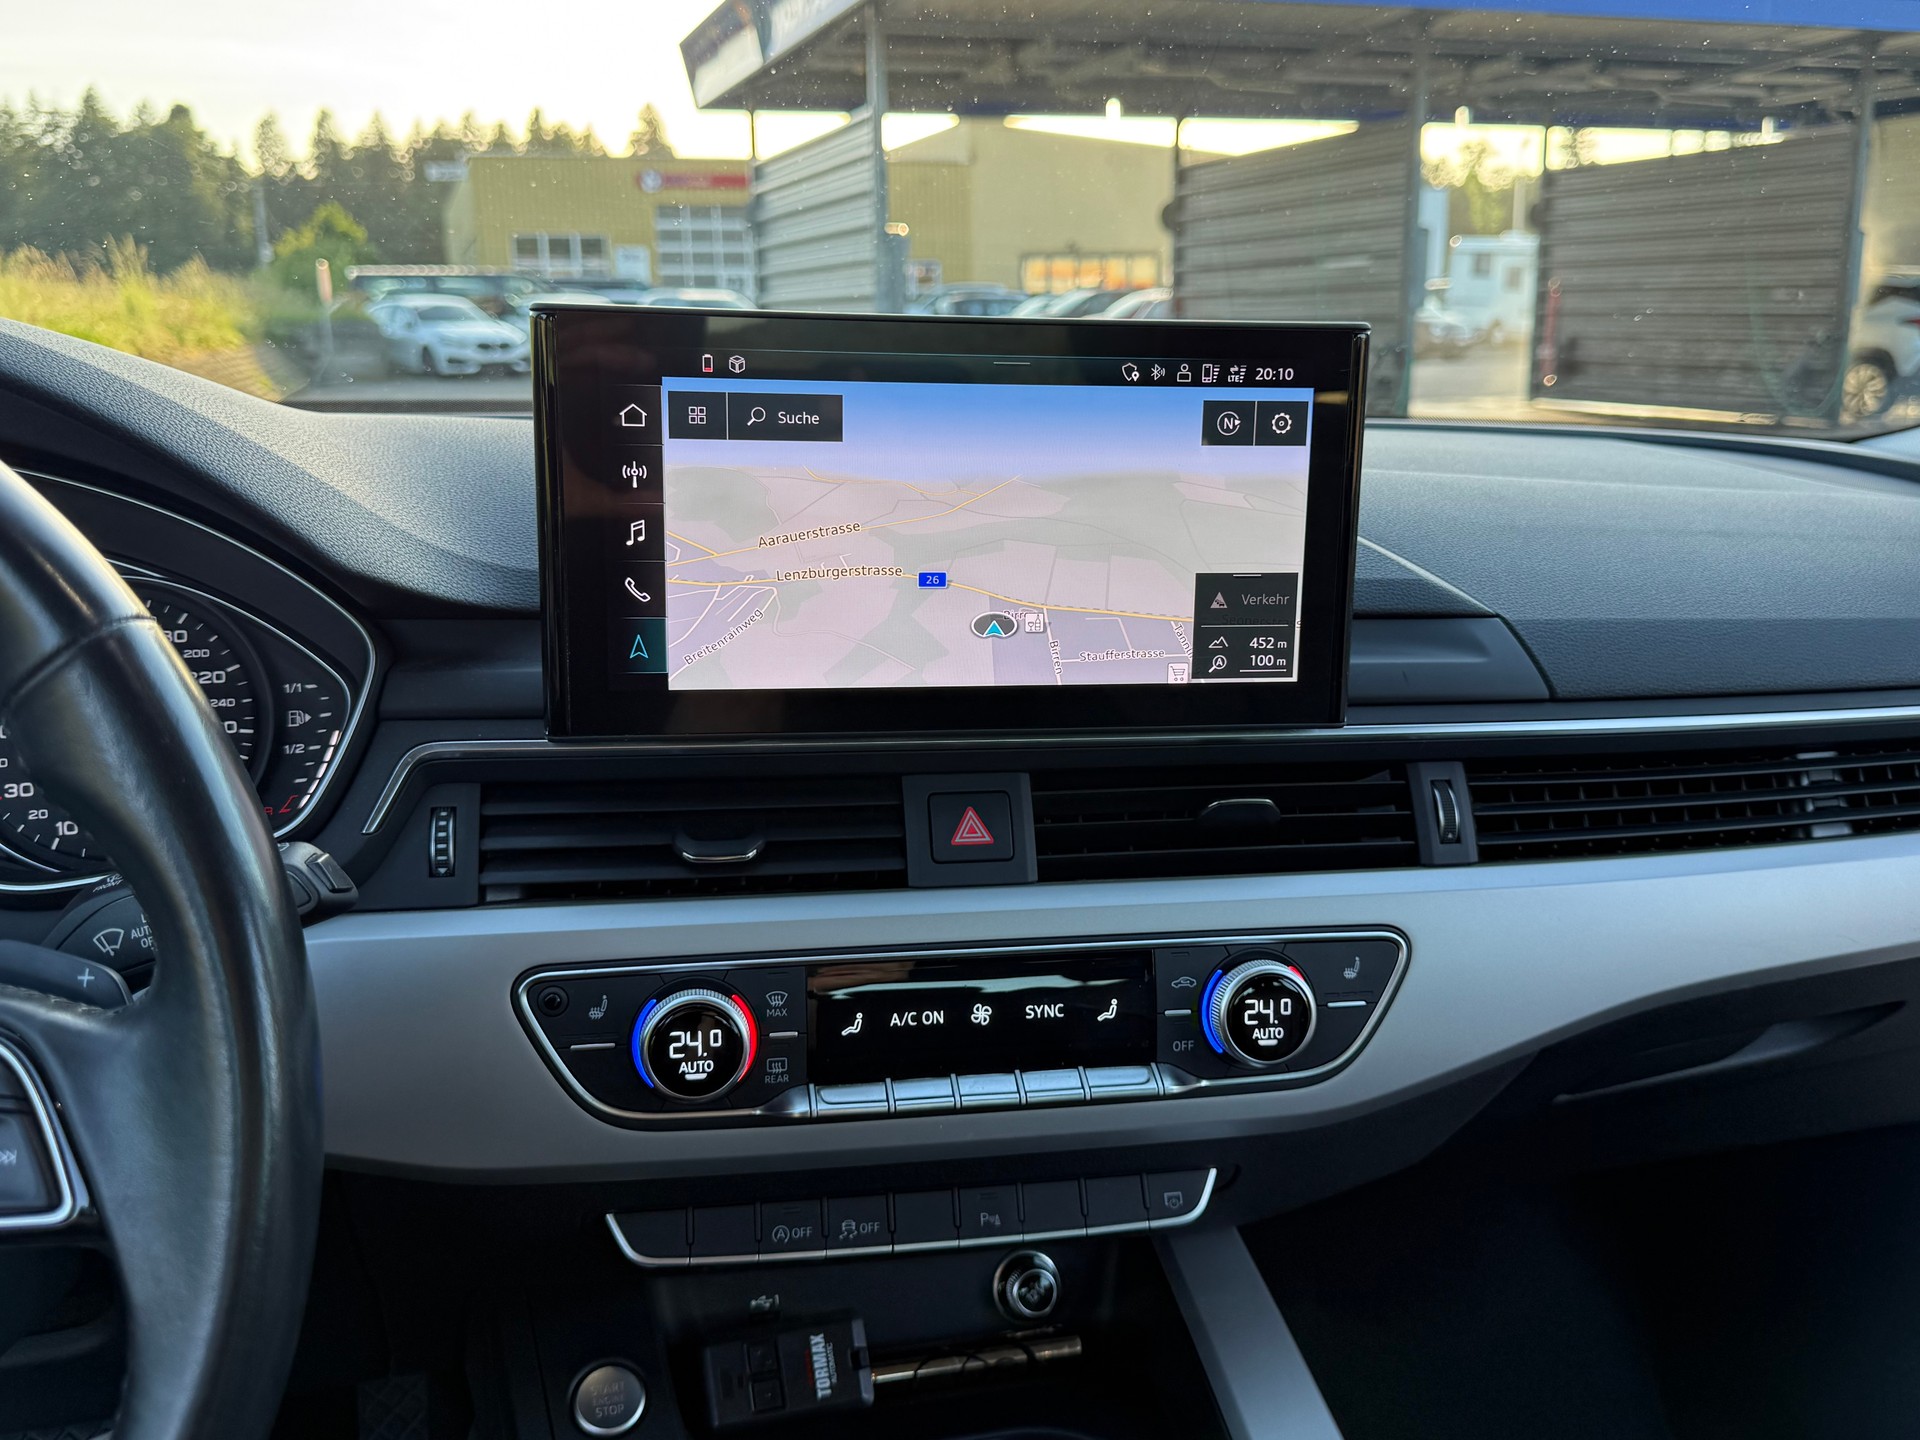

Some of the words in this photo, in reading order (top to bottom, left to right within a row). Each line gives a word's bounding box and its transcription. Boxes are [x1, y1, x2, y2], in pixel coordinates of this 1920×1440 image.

[1255, 367, 1295, 381] 20:10
[777, 411, 820, 425] Suche
[757, 521, 861, 548] Aarauerstrasse
[776, 565, 903, 582] Lenzburgerstrasse
[925, 575, 940, 585] 26
[1241, 594, 1290, 605] Verkehr
[163, 630, 188, 643] 80
[683, 608, 764, 665] Breitenrainweg
[1249, 637, 1275, 649] 452
[1277, 641, 1288, 649] m
[183, 649, 210, 658] 200
[1049, 640, 1062, 675] Birren
[1079, 649, 1165, 661] Staufferstrasse
[1250, 655, 1274, 667] 100
[1276, 658, 1287, 666] m
[283, 682, 302, 693] 1/1
[210, 698, 236, 707] 240
[283, 744, 305, 754] 1/2
[4, 782, 34, 798] 30
[28, 809, 49, 820] 20
[55, 821, 79, 836] 10
[131, 925, 152, 939] AUT
[141, 936, 153, 948] OF
[766, 1007, 788, 1017] MAX
[1025, 1003, 1065, 1019] SYNC
[890, 1011, 917, 1027] A/C
[921, 1010, 944, 1025] ON
[1252, 1027, 1284, 1040] AUTO
[1172, 1040, 1195, 1052] OFF
[678, 1060, 714, 1075] AUTO
[765, 1075, 790, 1084] REAR
[791, 1226, 813, 1239] OFF
[859, 1221, 881, 1234] OFF
[809, 1332, 833, 1402] TORMAX
[595, 1403, 625, 1418] STOP
